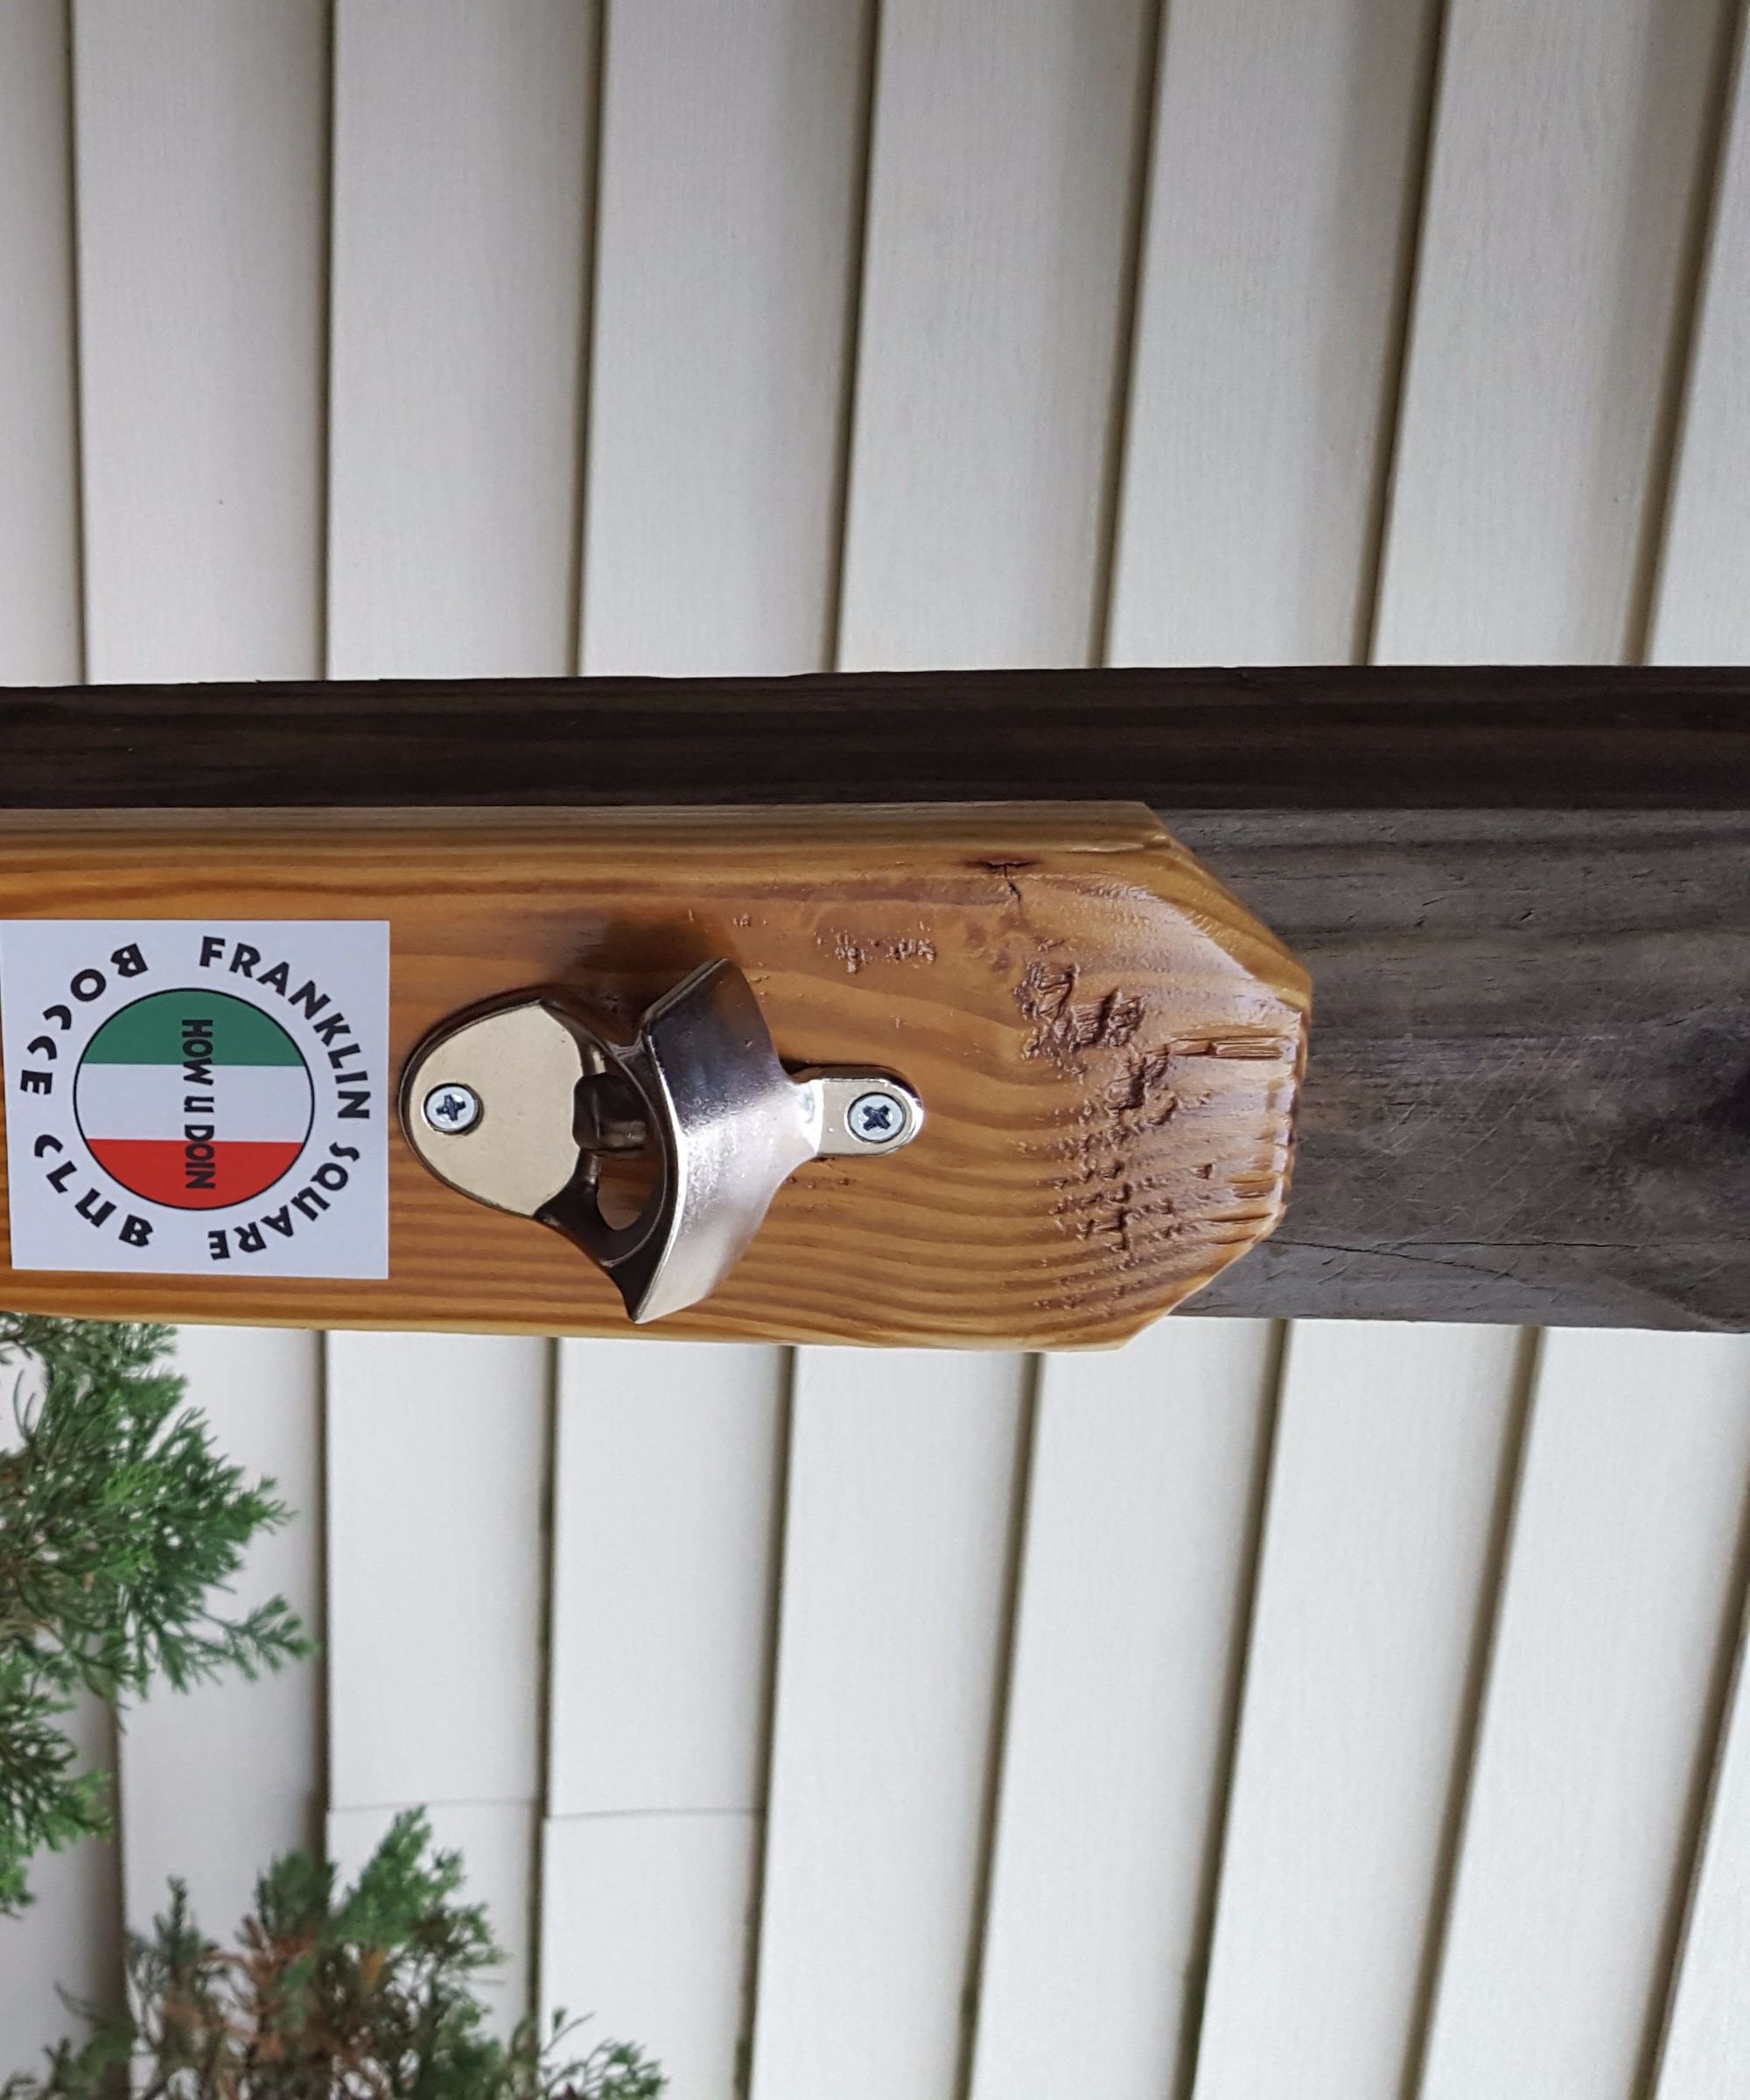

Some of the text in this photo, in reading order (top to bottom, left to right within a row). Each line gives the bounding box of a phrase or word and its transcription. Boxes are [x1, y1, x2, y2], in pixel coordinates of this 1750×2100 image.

[19, 942, 154, 1248] BOCCE CLUB
[181, 1018, 214, 1086] HOW
[199, 935, 371, 1260] FRANKLIN SQUARE
[184, 1124, 215, 1190] DOIN
